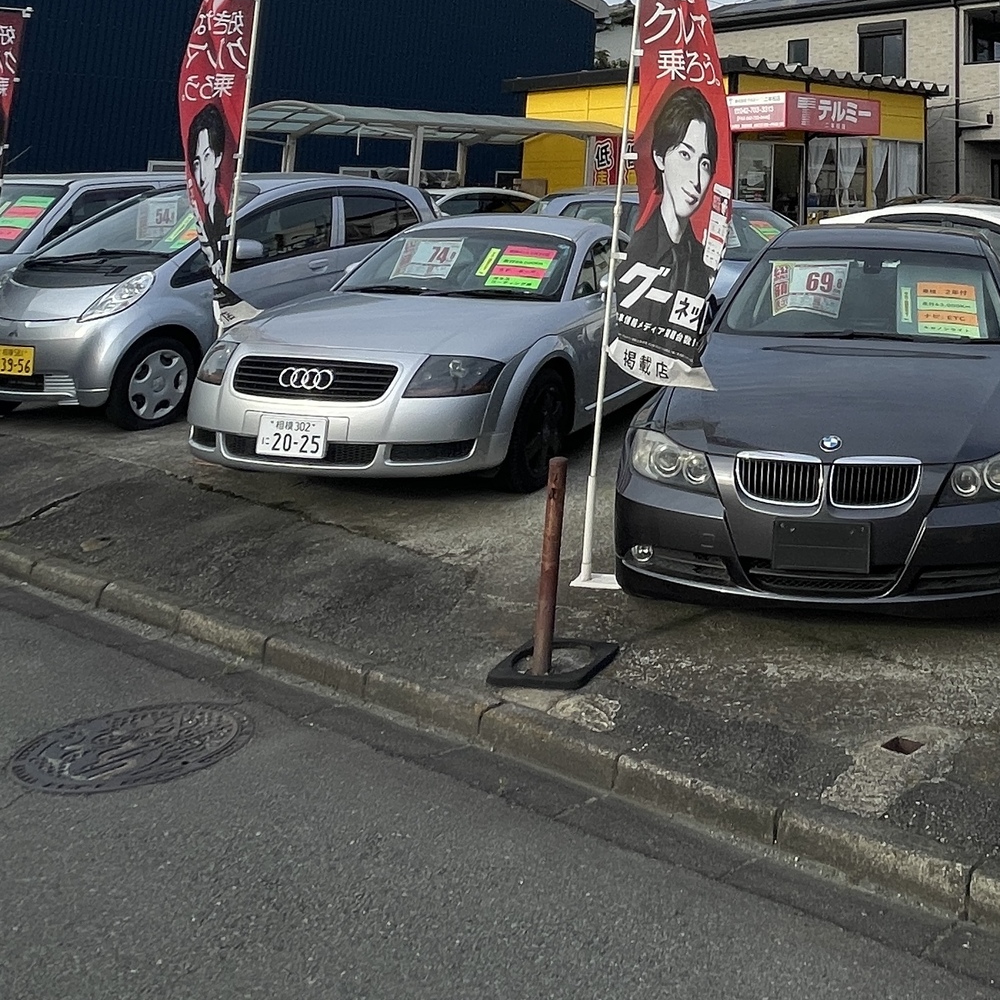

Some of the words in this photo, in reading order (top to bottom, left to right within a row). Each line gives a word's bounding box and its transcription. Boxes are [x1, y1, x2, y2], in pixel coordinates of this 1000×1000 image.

[644, 2, 708, 46] クルマ
[656, 49, 721, 87] 乗ろう。
[818, 99, 872, 124] テルミー
[619, 262, 674, 308] グー
[1, 358, 30, 373] 39-56
[623, 348, 669, 379] 掲載店
[262, 437, 270, 445] に
[271, 433, 321, 454] 20-25
